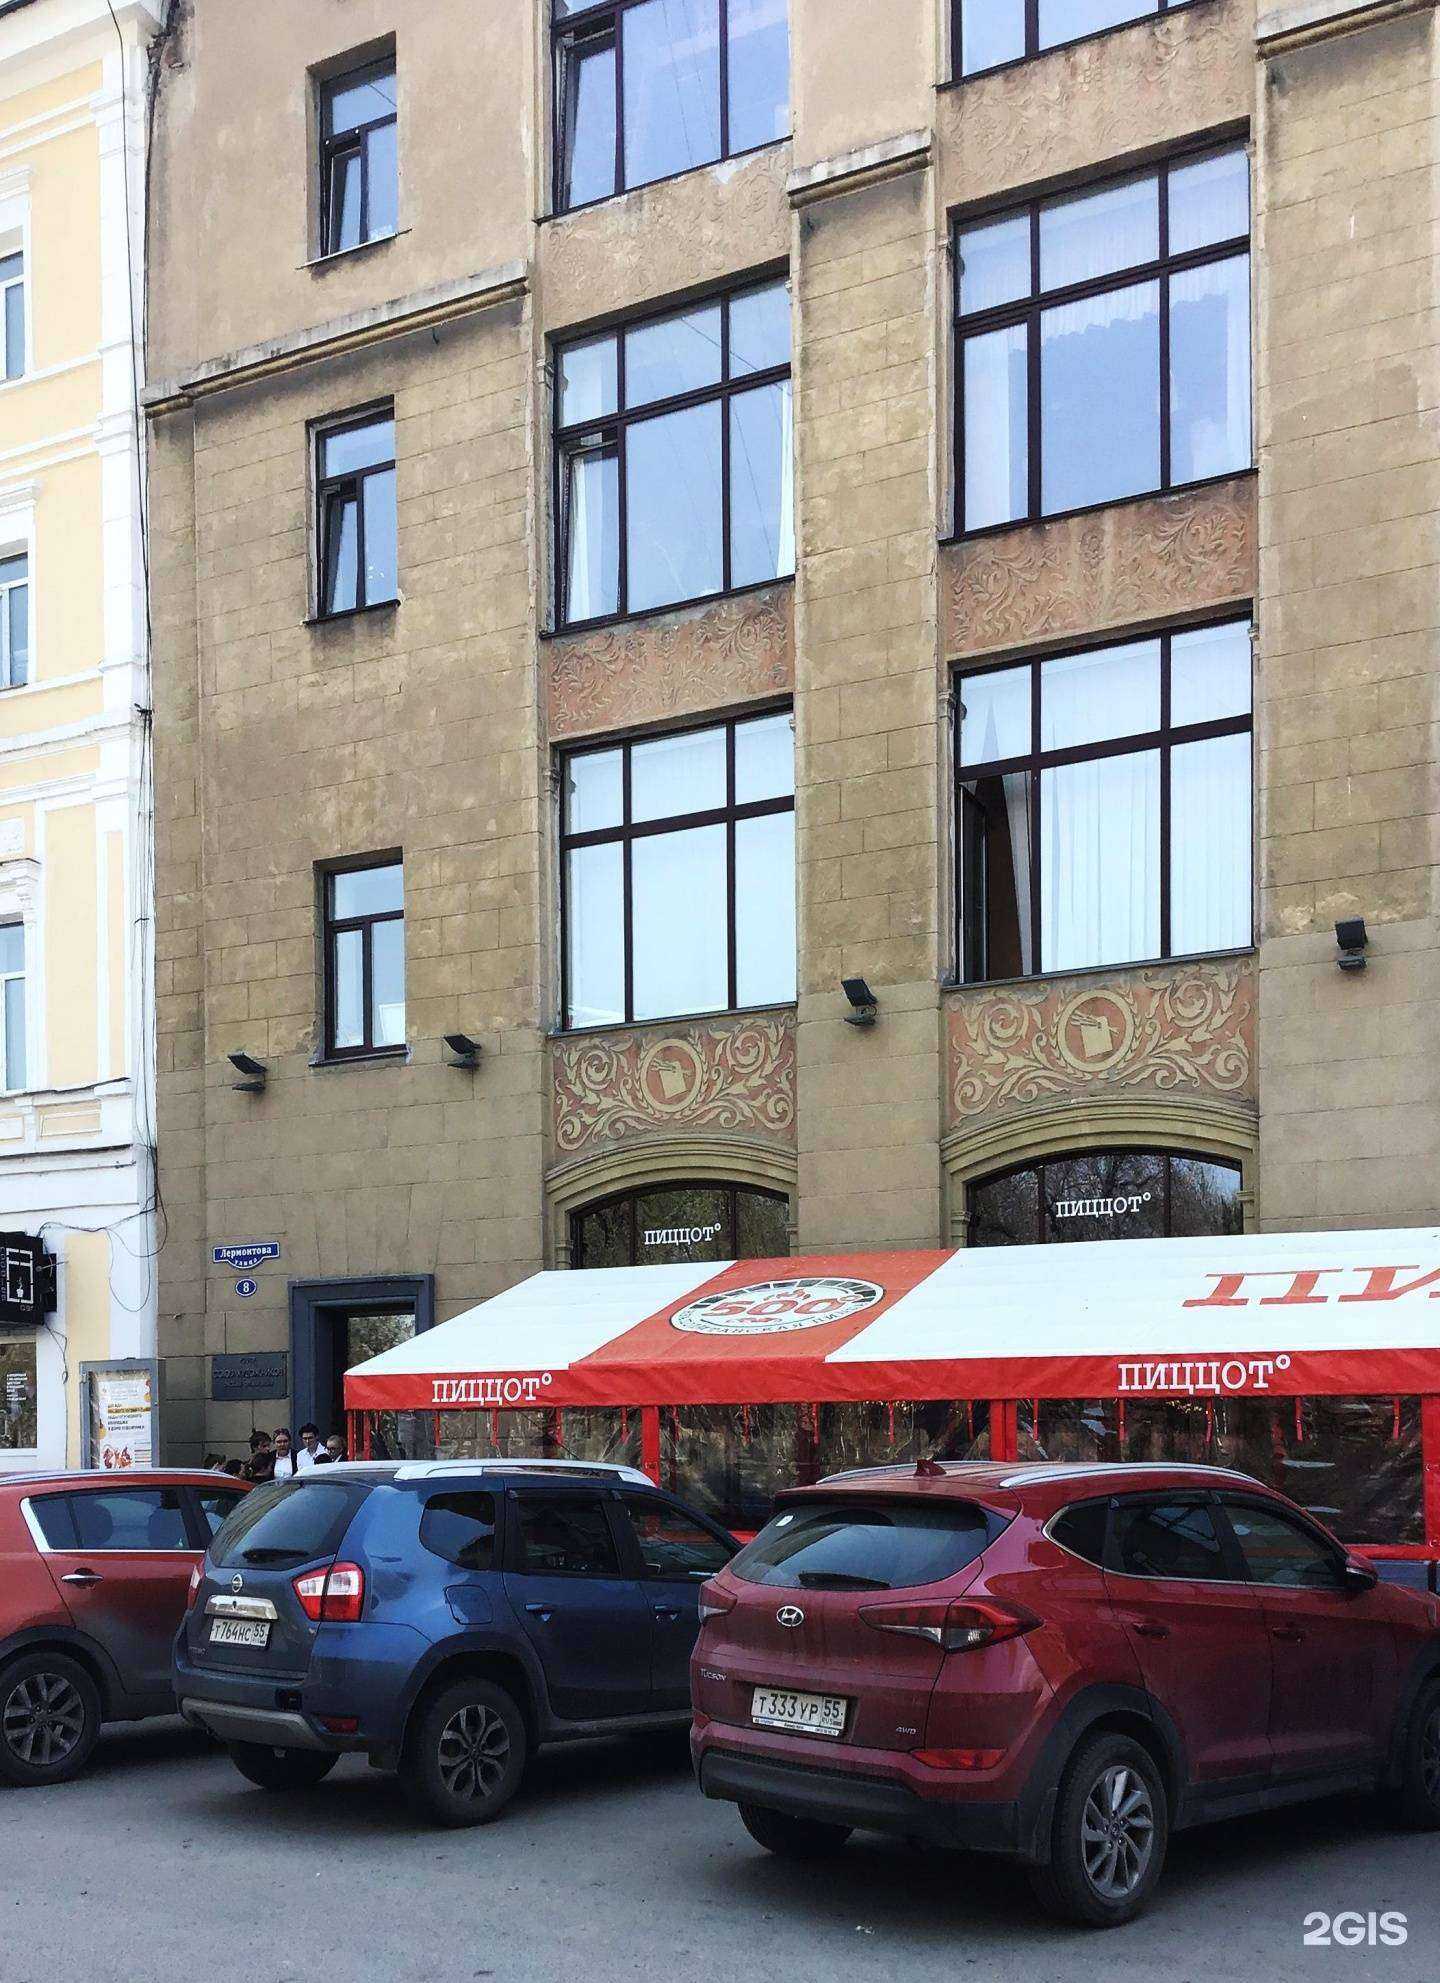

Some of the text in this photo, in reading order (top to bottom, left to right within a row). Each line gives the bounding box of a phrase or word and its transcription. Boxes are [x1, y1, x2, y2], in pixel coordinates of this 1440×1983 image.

[220, 1247, 272, 1259] Лермонтова
[243, 1281, 250, 1293] 8
[214, 1621, 266, 1641] Т764НС 55
[759, 1693, 840, 1720] Т333УР 55
